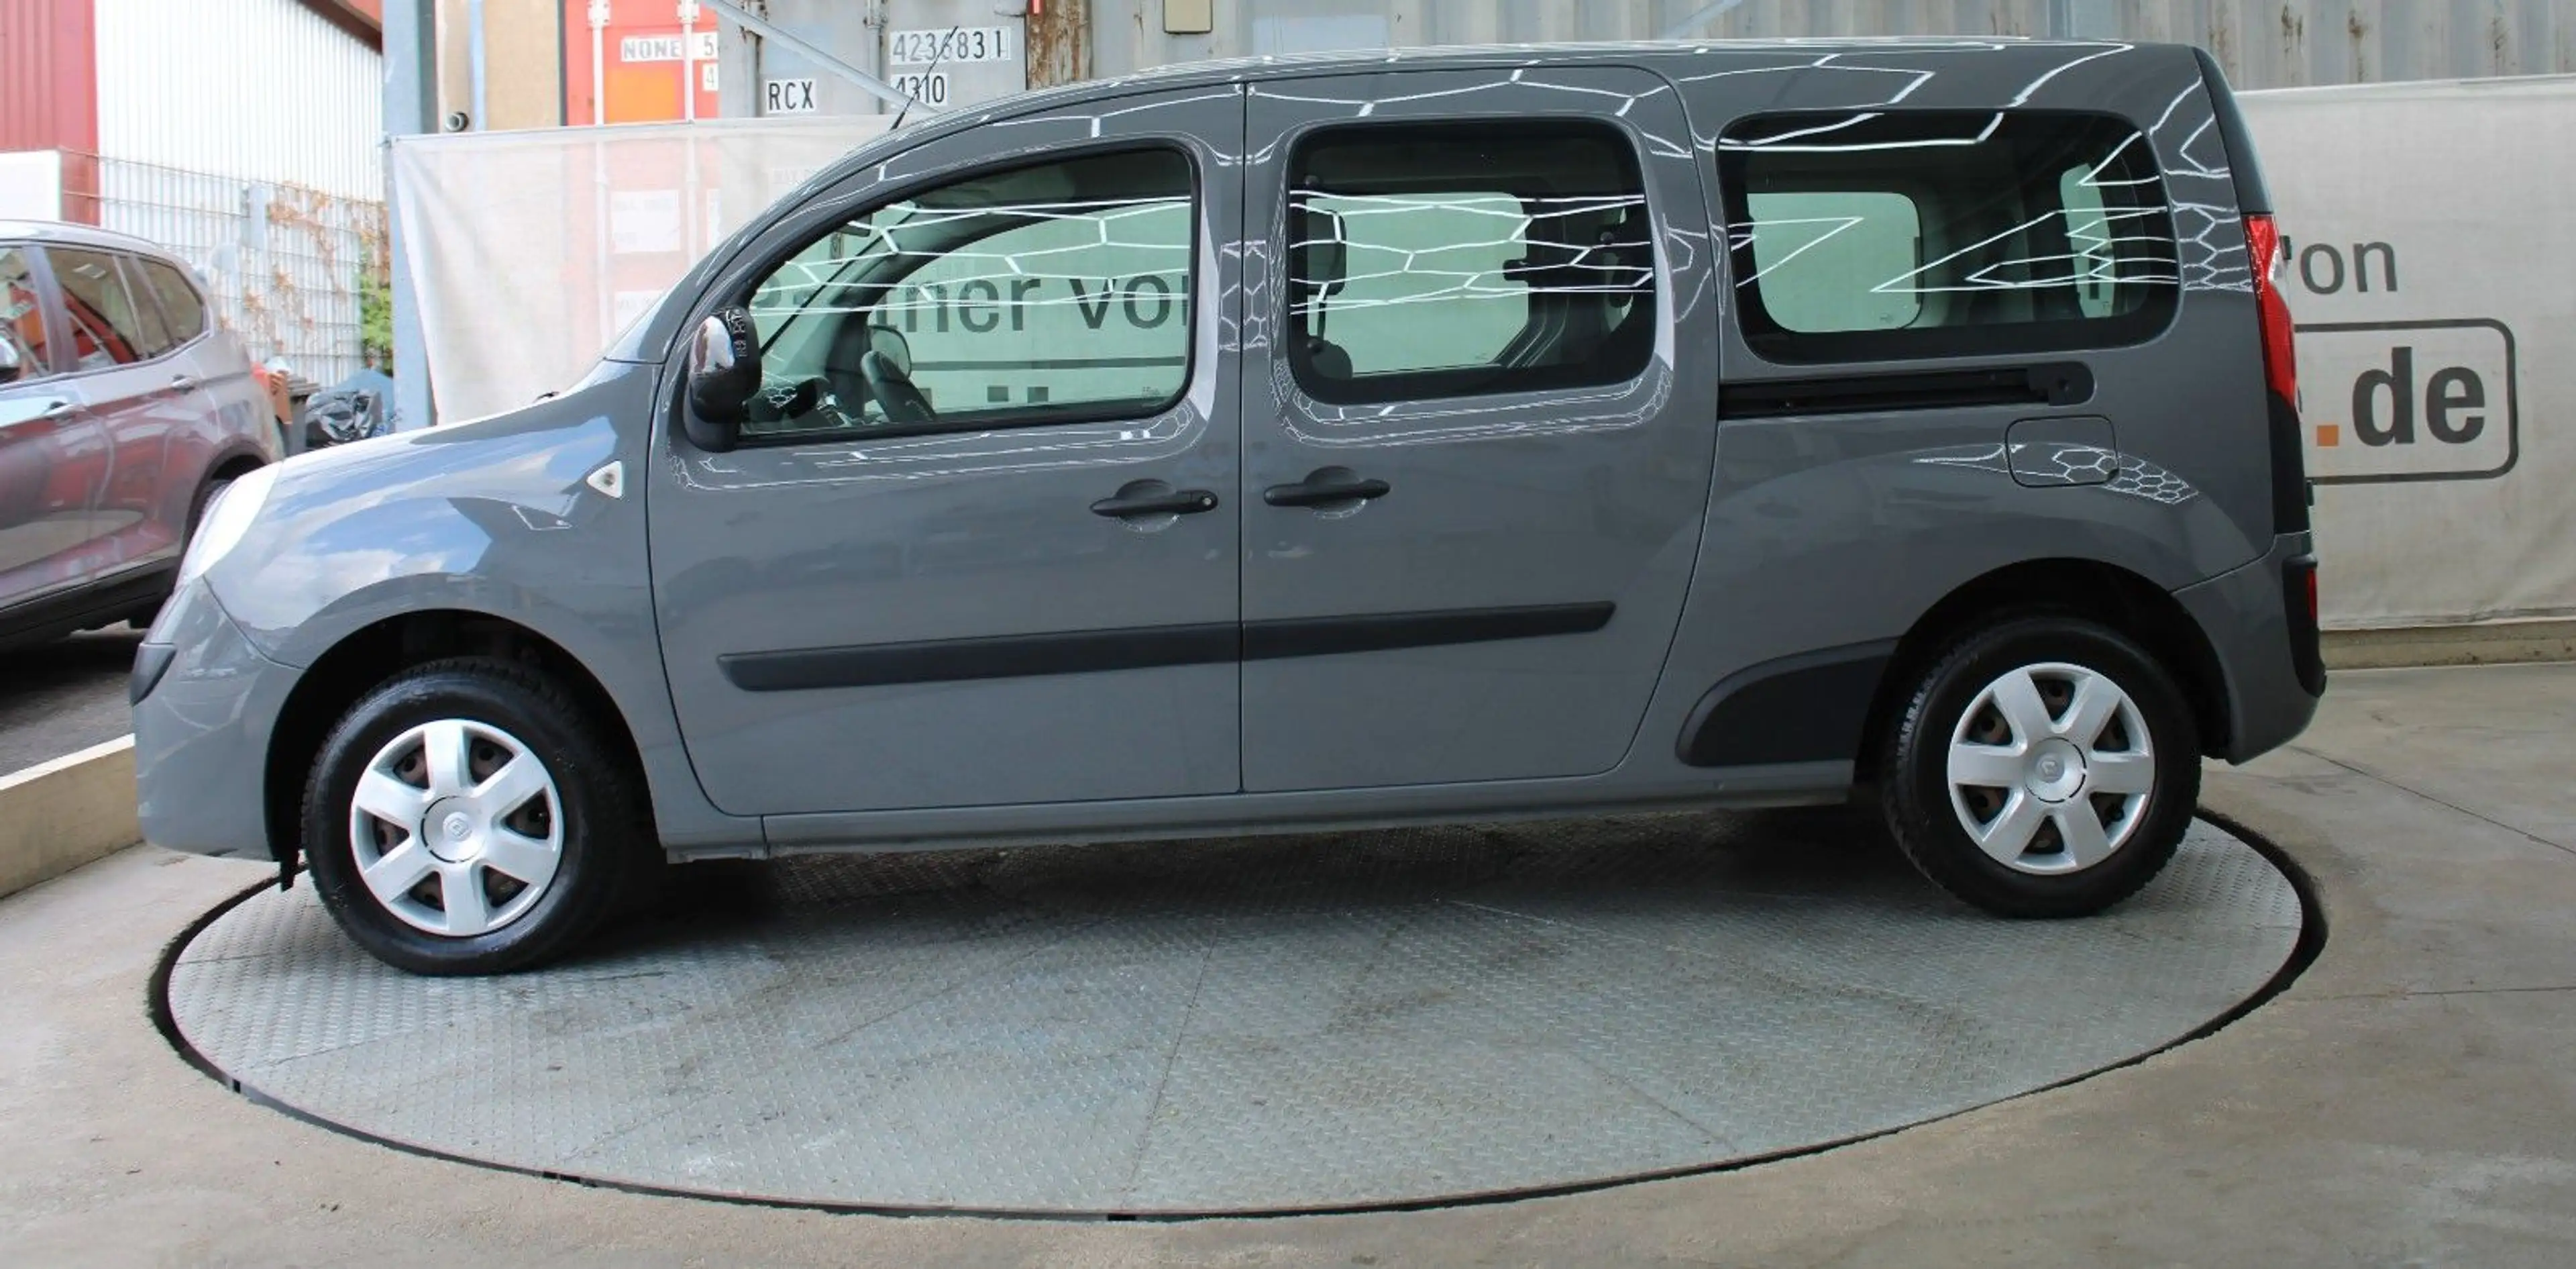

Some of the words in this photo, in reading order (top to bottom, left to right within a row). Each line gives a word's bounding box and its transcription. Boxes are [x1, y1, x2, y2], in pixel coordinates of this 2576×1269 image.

[768, 81, 814, 110] RCX
[2300, 241, 2398, 295] on
[1069, 274, 1189, 329] vo
[2299, 346, 2485, 447] .de
